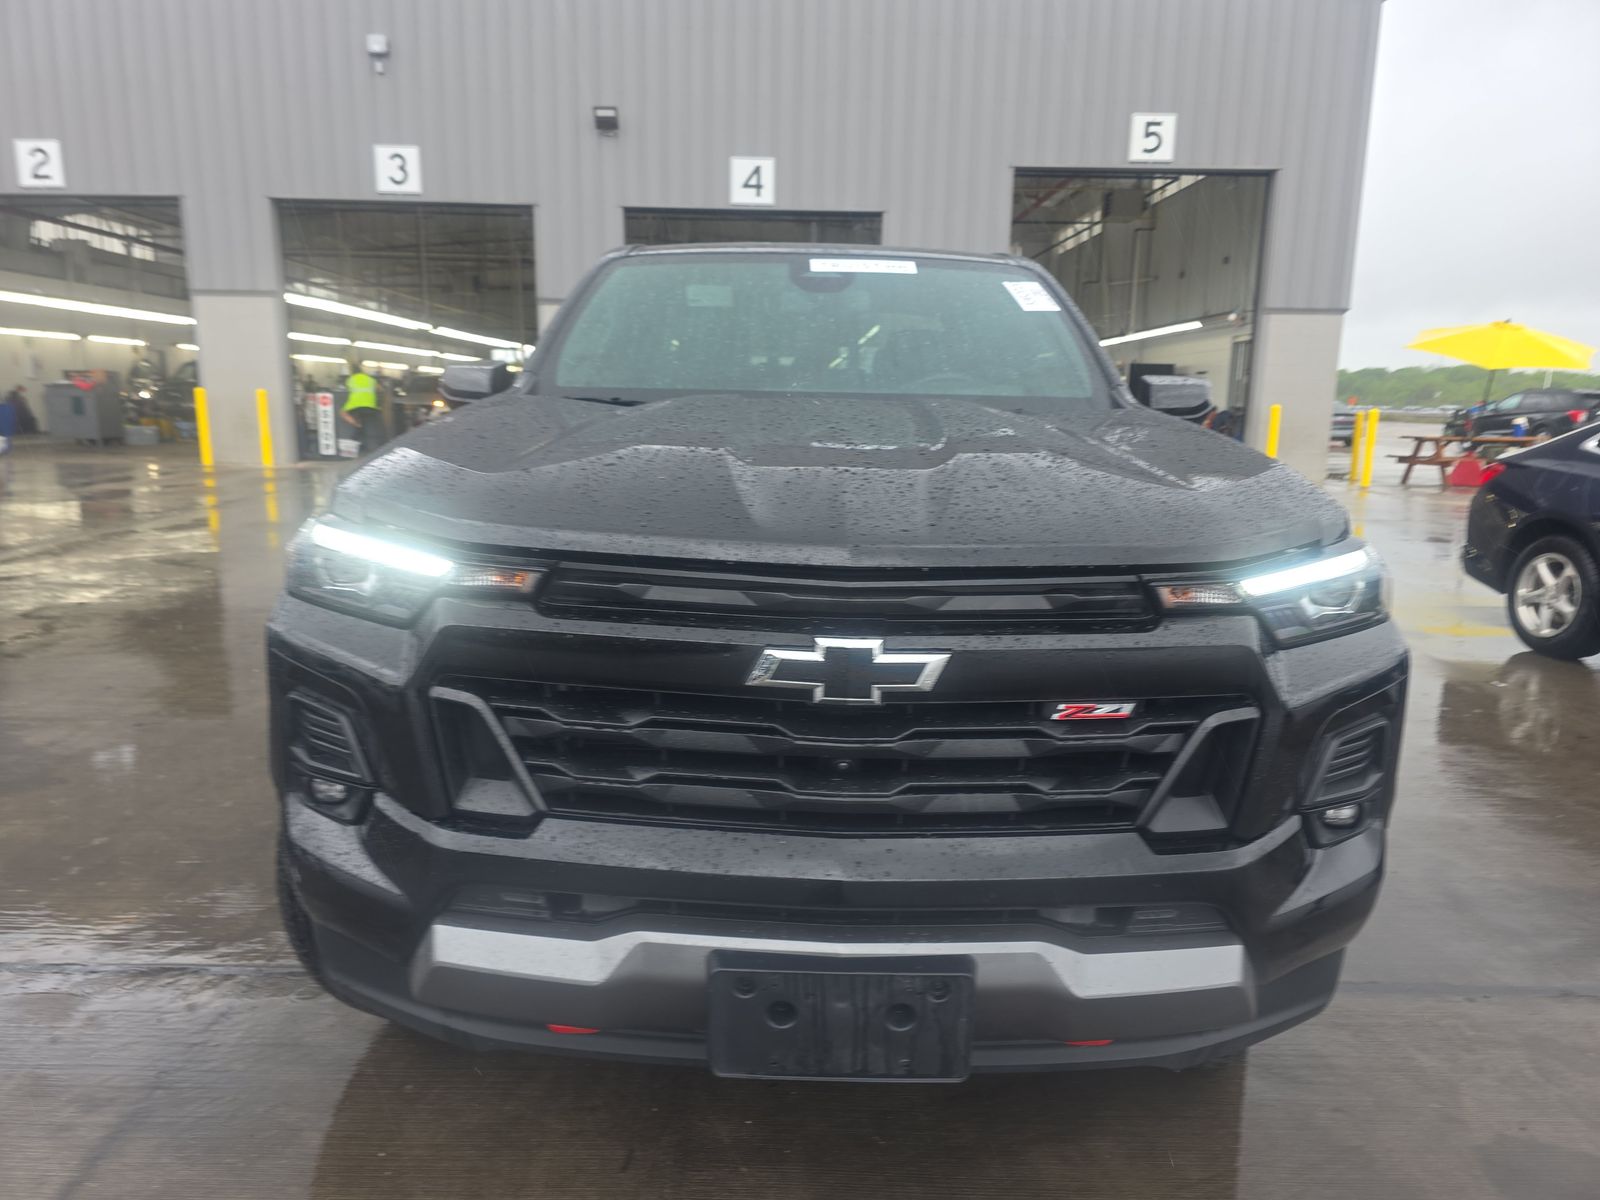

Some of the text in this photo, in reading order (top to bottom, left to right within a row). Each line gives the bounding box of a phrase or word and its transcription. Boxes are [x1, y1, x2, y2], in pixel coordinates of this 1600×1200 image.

[1142, 122, 1163, 153] 5
[31, 148, 52, 180] 2
[389, 154, 408, 185] 3
[743, 166, 764, 197] 4
